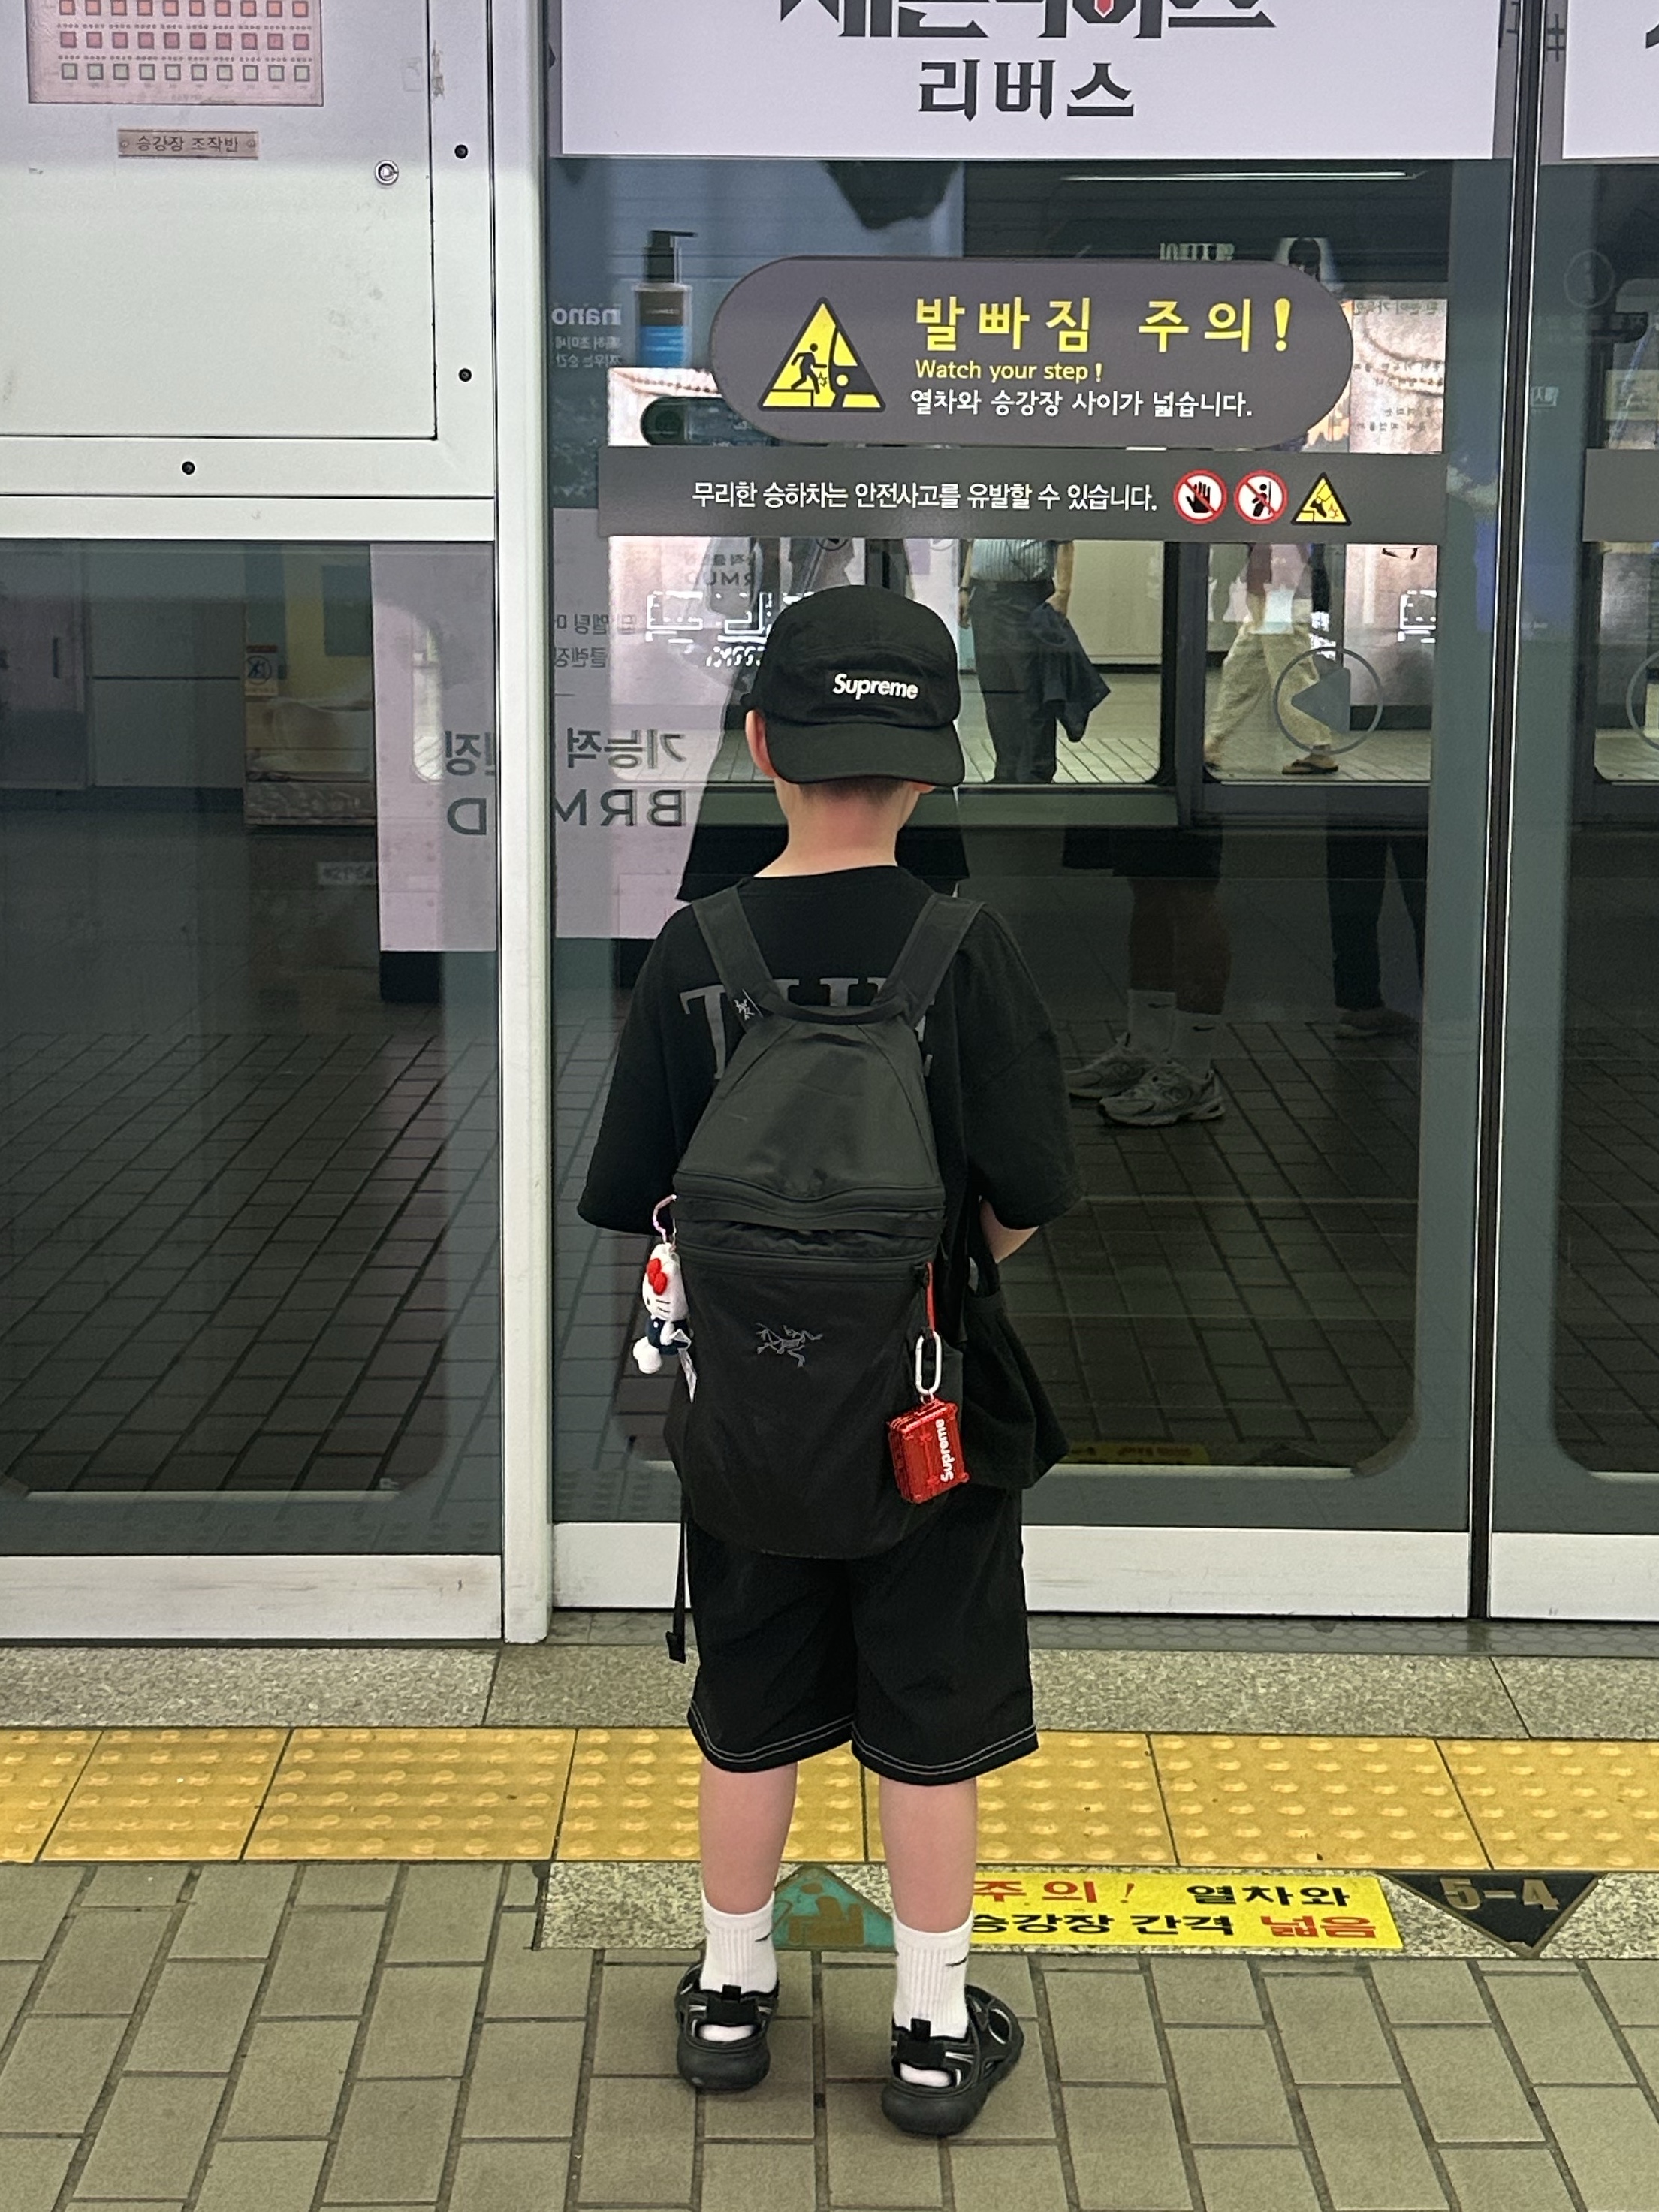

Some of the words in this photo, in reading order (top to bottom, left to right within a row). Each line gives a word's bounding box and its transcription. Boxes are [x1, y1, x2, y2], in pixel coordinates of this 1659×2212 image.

[918, 59, 1134, 121] 리버스
[137, 135, 185, 152] 승강장
[192, 136, 238, 153] 조작반
[915, 296, 1090, 352] 발빠짐
[915, 359, 982, 379] Watch
[989, 365, 1037, 383] your
[910, 388, 982, 415] 열차와
[990, 389, 1063, 416] 승강장
[1072, 391, 1144, 416] 사이가
[1154, 391, 1253, 418] 넓습니다.
[692, 481, 758, 508] 무리한
[762, 482, 849, 508] 승하차는
[855, 482, 961, 509] 안전사고를
[967, 483, 1033, 509] 유발할
[1037, 484, 1060, 510] 수
[1067, 484, 1157, 511] 있습니다.
[833, 673, 918, 700] Supreme
[935, 1418, 955, 1482] Supreme
[1186, 1885, 1351, 1906] 열차와
[1440, 1878, 1560, 1910] 5-4
[972, 1913, 1115, 1935] 승강장
[1130, 1915, 1235, 1936] 간격
[1261, 1915, 1377, 1939] 넓음
